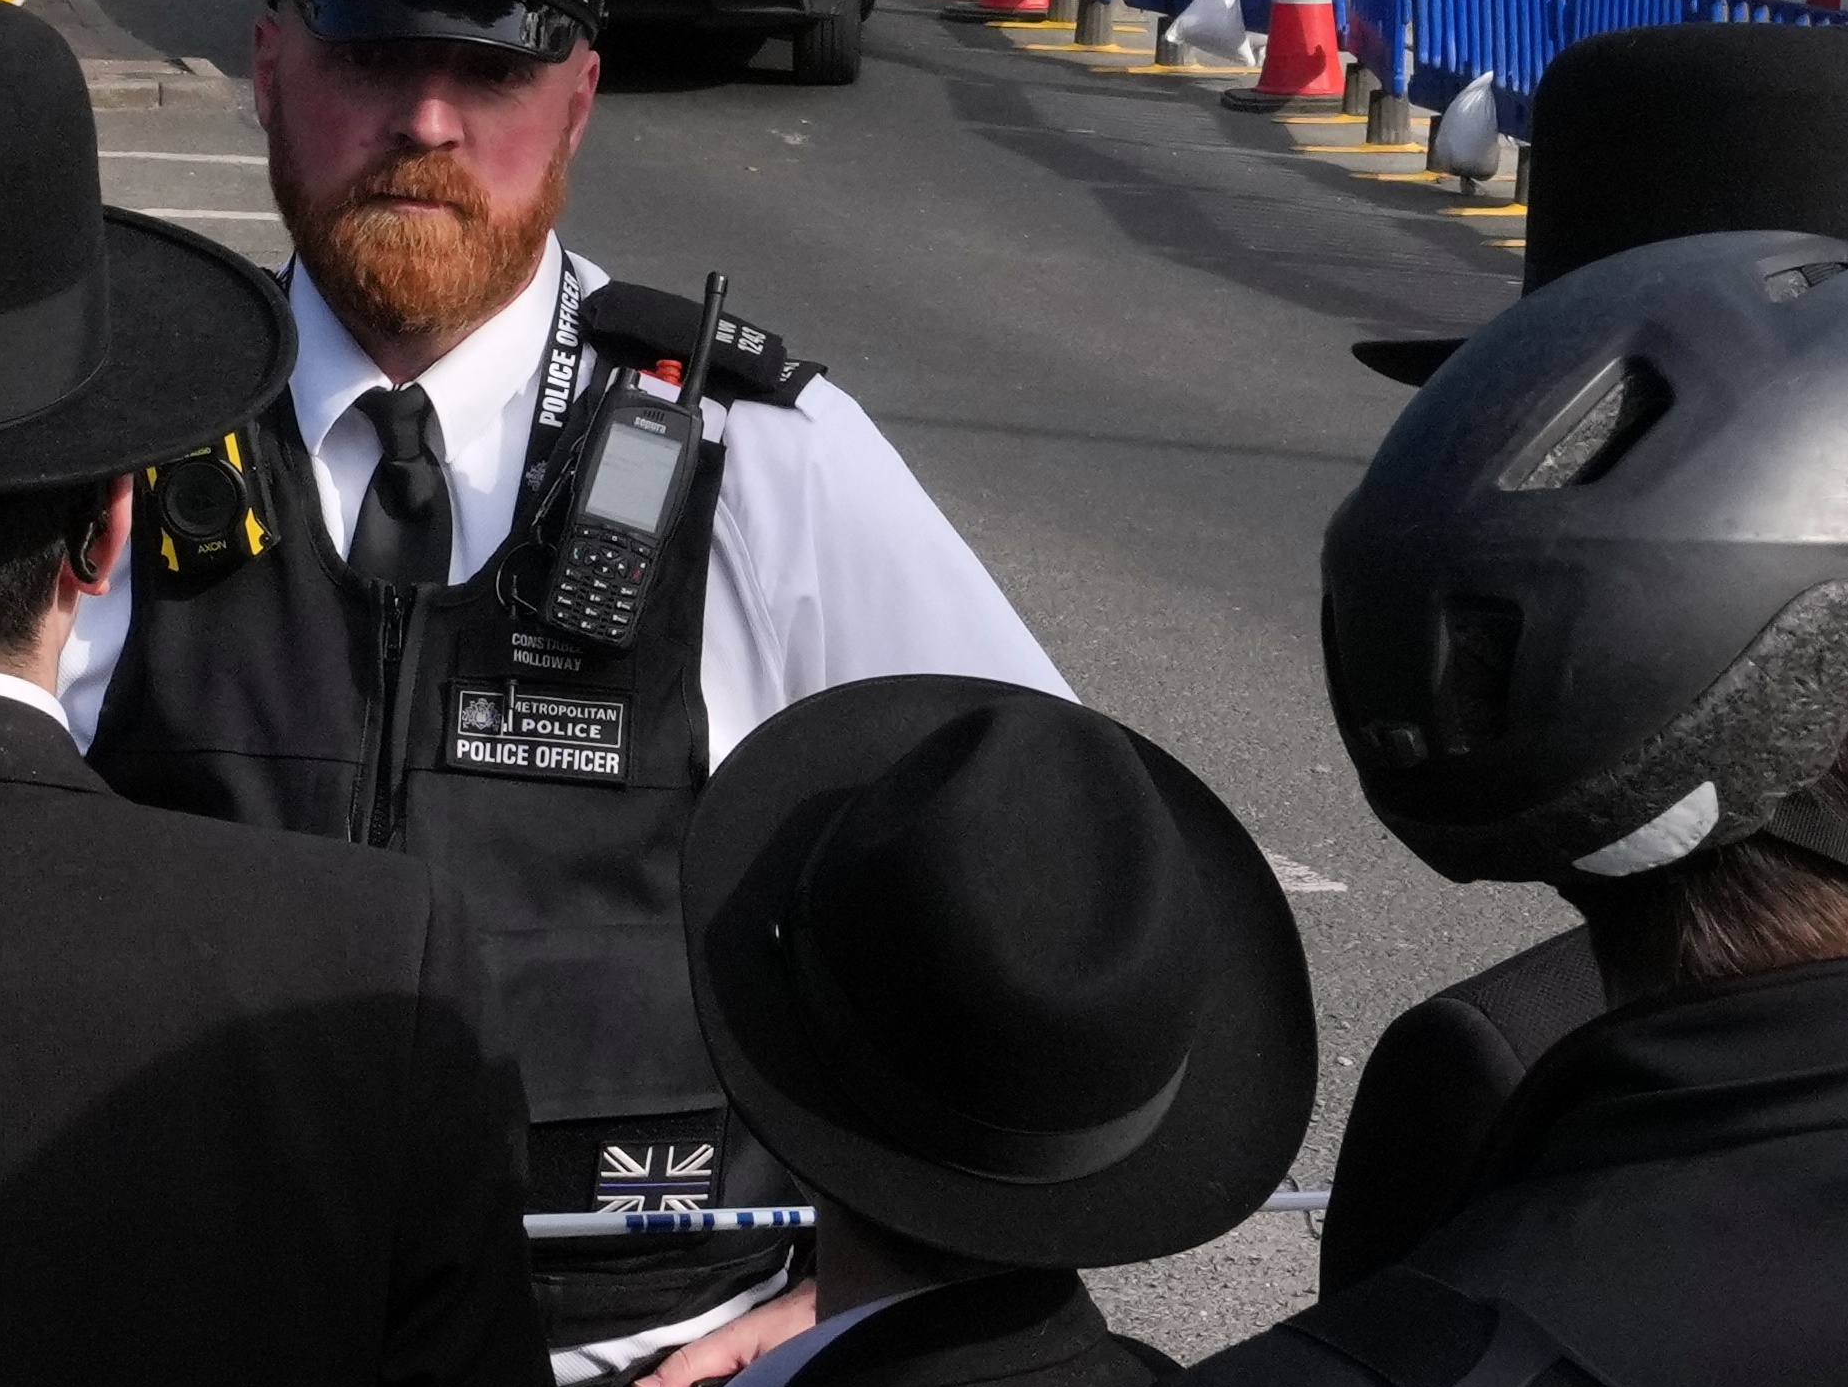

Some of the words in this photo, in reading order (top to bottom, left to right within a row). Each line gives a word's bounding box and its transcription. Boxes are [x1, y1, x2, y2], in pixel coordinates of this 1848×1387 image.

[555, 270, 581, 348] OFFICER
[538, 349, 577, 429] POLICE
[634, 416, 667, 435] sepura
[198, 540, 227, 555] AXON
[513, 648, 583, 672] HOLLOWAY
[521, 718, 602, 739] POLICE
[456, 739, 530, 766] POLICE
[535, 745, 620, 775] OFFICER
